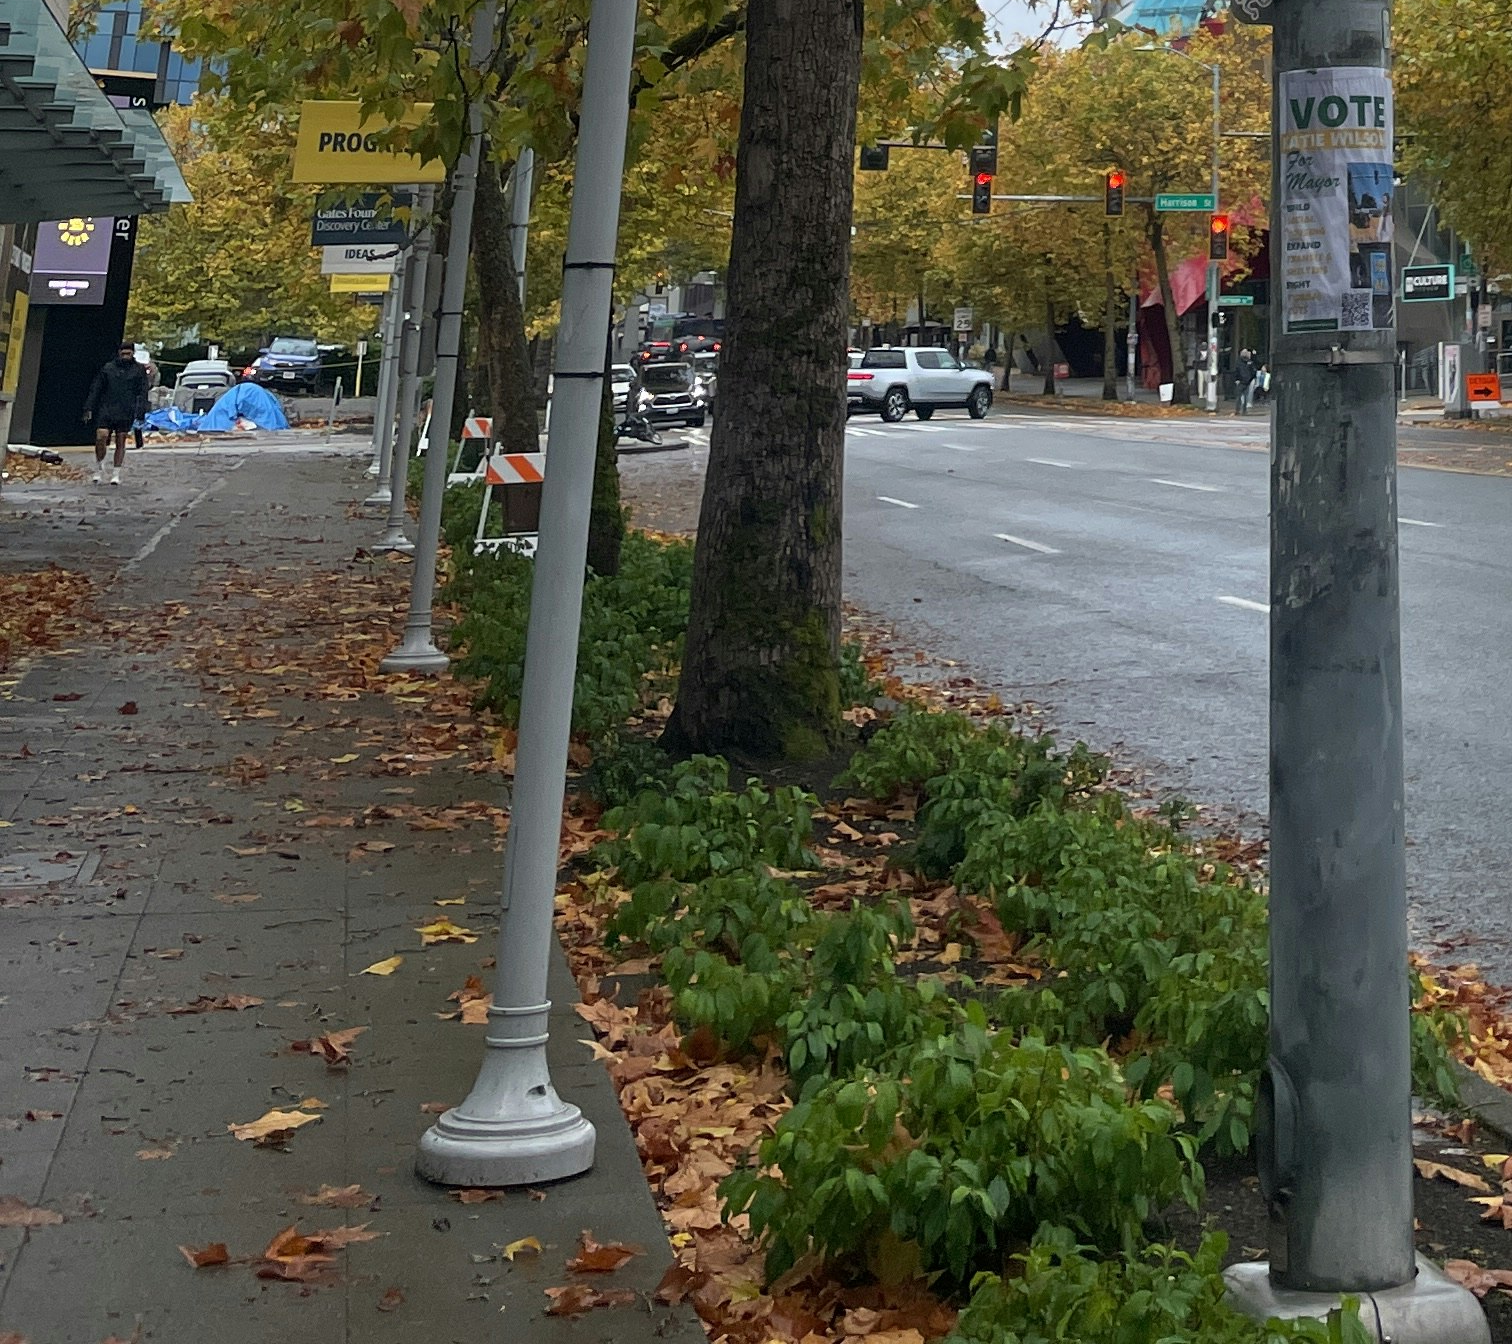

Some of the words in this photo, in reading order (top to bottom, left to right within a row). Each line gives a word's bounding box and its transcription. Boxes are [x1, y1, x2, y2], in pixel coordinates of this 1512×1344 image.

[1289, 95, 1385, 129] VOTE
[1286, 150, 1313, 173] For
[1286, 173, 1341, 193] Mayor
[1160, 198, 1197, 207] Harrison
[1204, 199, 1212, 207] St
[317, 208, 347, 220] Gates
[316, 220, 360, 234] Discovery
[361, 220, 390, 230] Ceter
[1287, 241, 1321, 251] EXPAND
[344, 249, 376, 260] IDEAS
[1414, 274, 1448, 286] CULTURE
[956, 319, 970, 329] 25
